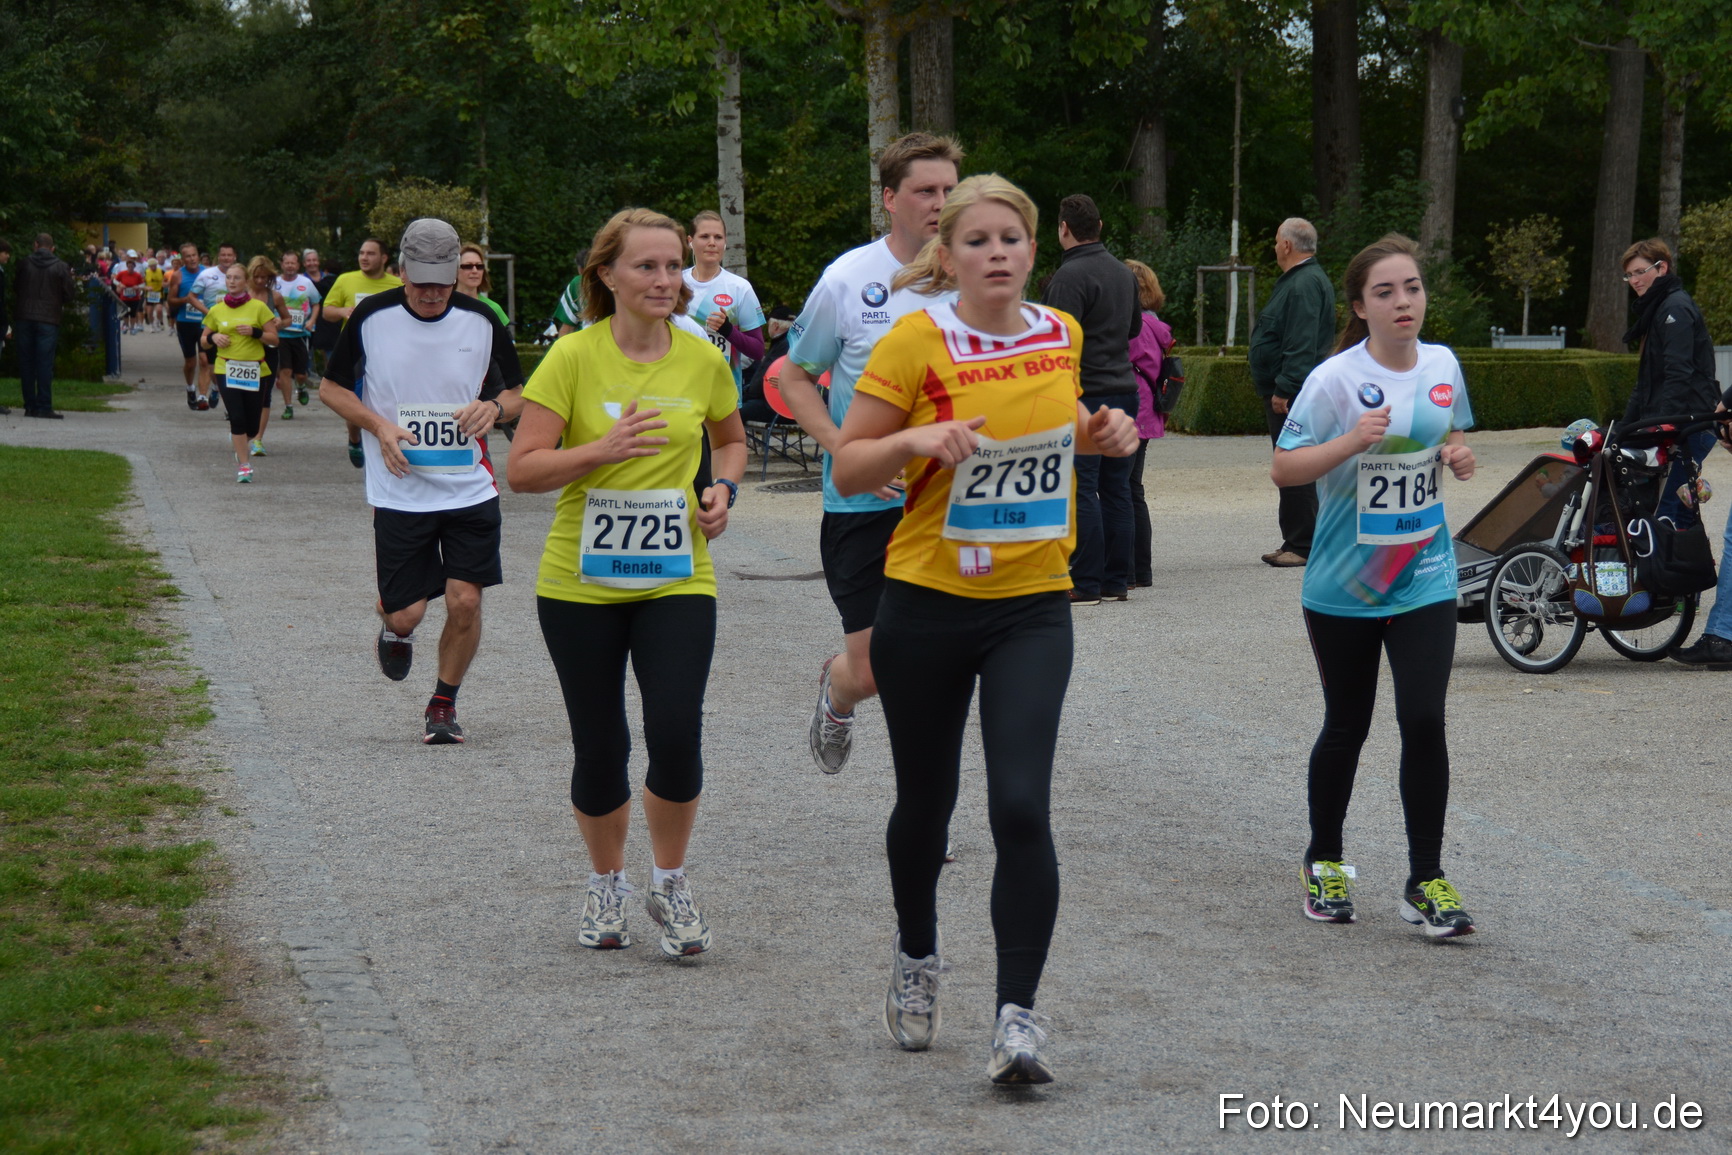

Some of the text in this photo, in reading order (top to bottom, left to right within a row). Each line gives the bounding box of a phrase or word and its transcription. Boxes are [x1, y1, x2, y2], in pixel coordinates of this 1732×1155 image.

[229, 366, 257, 380] 2265
[956, 354, 1072, 387] MAX BÖGL
[400, 410, 455, 418] PARTL Neuma
[971, 440, 1058, 459] ARTL Neumarkt
[1361, 456, 1434, 472] PARTL Neumarkt
[964, 453, 1061, 499] 2738
[1368, 467, 1438, 509] 2184
[588, 497, 674, 509] PARTL Neumarkt
[993, 508, 1027, 525] Lisa
[1395, 516, 1422, 532] Anja
[593, 513, 684, 551] 2725
[612, 559, 663, 575] Renate
